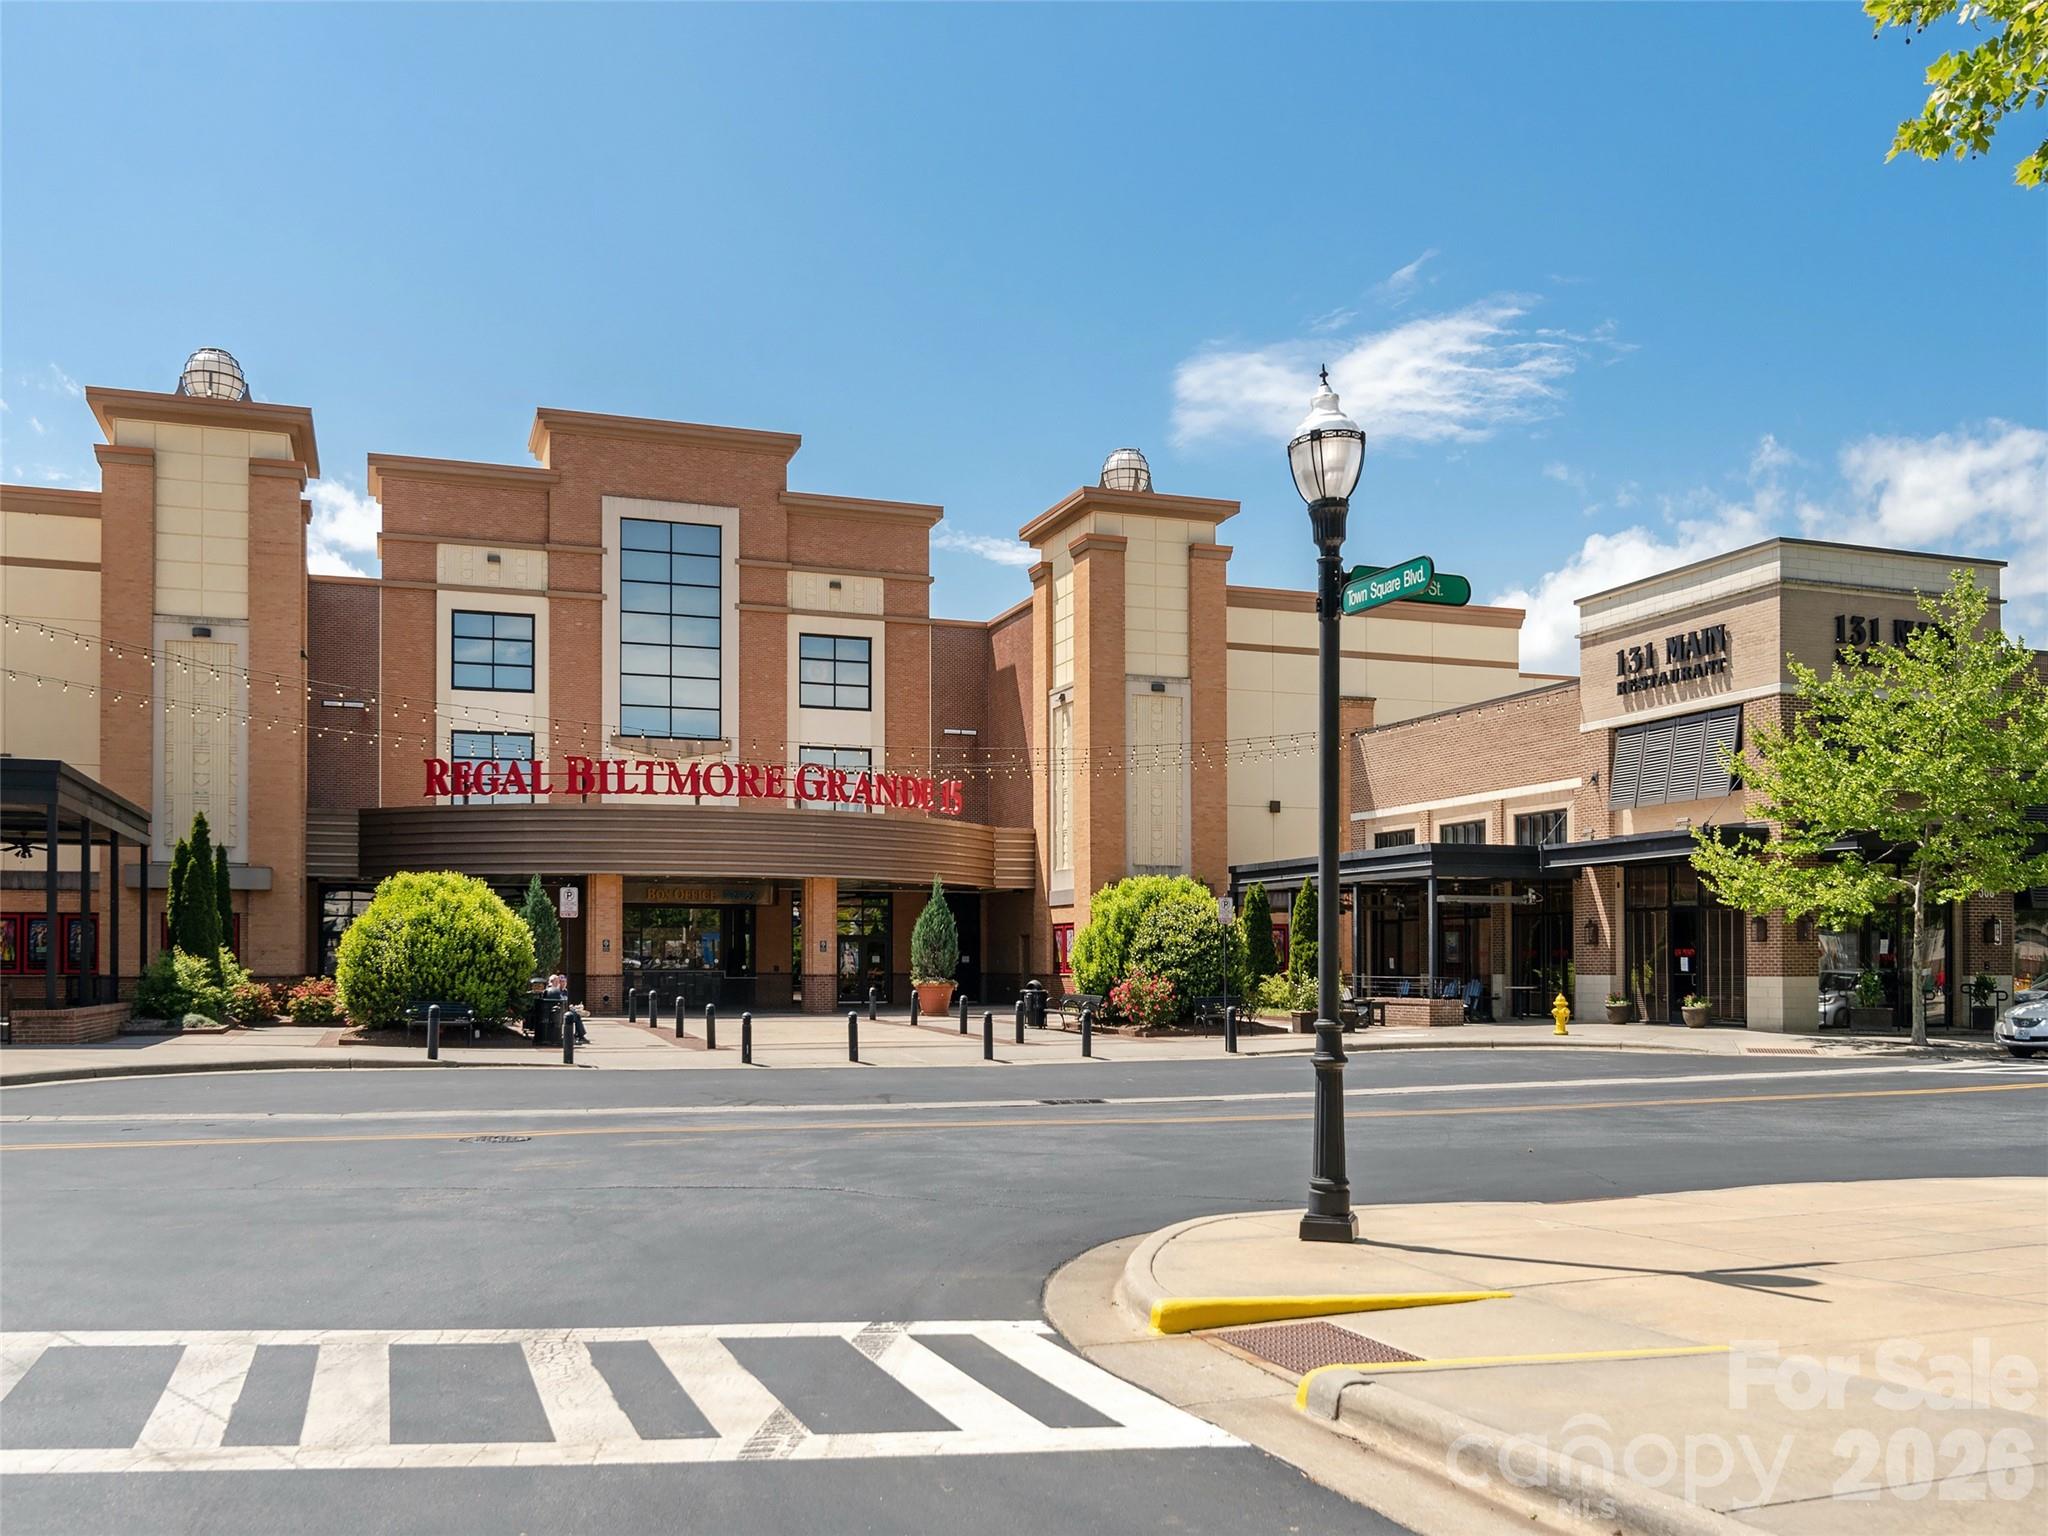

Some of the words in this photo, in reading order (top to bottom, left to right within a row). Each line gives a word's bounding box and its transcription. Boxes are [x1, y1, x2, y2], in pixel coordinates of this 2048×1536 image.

[1347, 588, 1368, 607] Town
[1370, 577, 1401, 599] Square
[1403, 565, 1426, 588] Blvd.
[1428, 581, 1444, 597] St.
[1834, 614, 1880, 647] 131
[1616, 642, 1655, 677] 131
[1665, 624, 1727, 665] MAIN
[1616, 657, 1727, 696] RESTAURANT
[424, 757, 554, 797] REGAL
[565, 755, 787, 800] BILTMORE
[793, 762, 935, 811] GRANDE
[940, 779, 963, 815] 15
[674, 887, 717, 900] OFFICE
